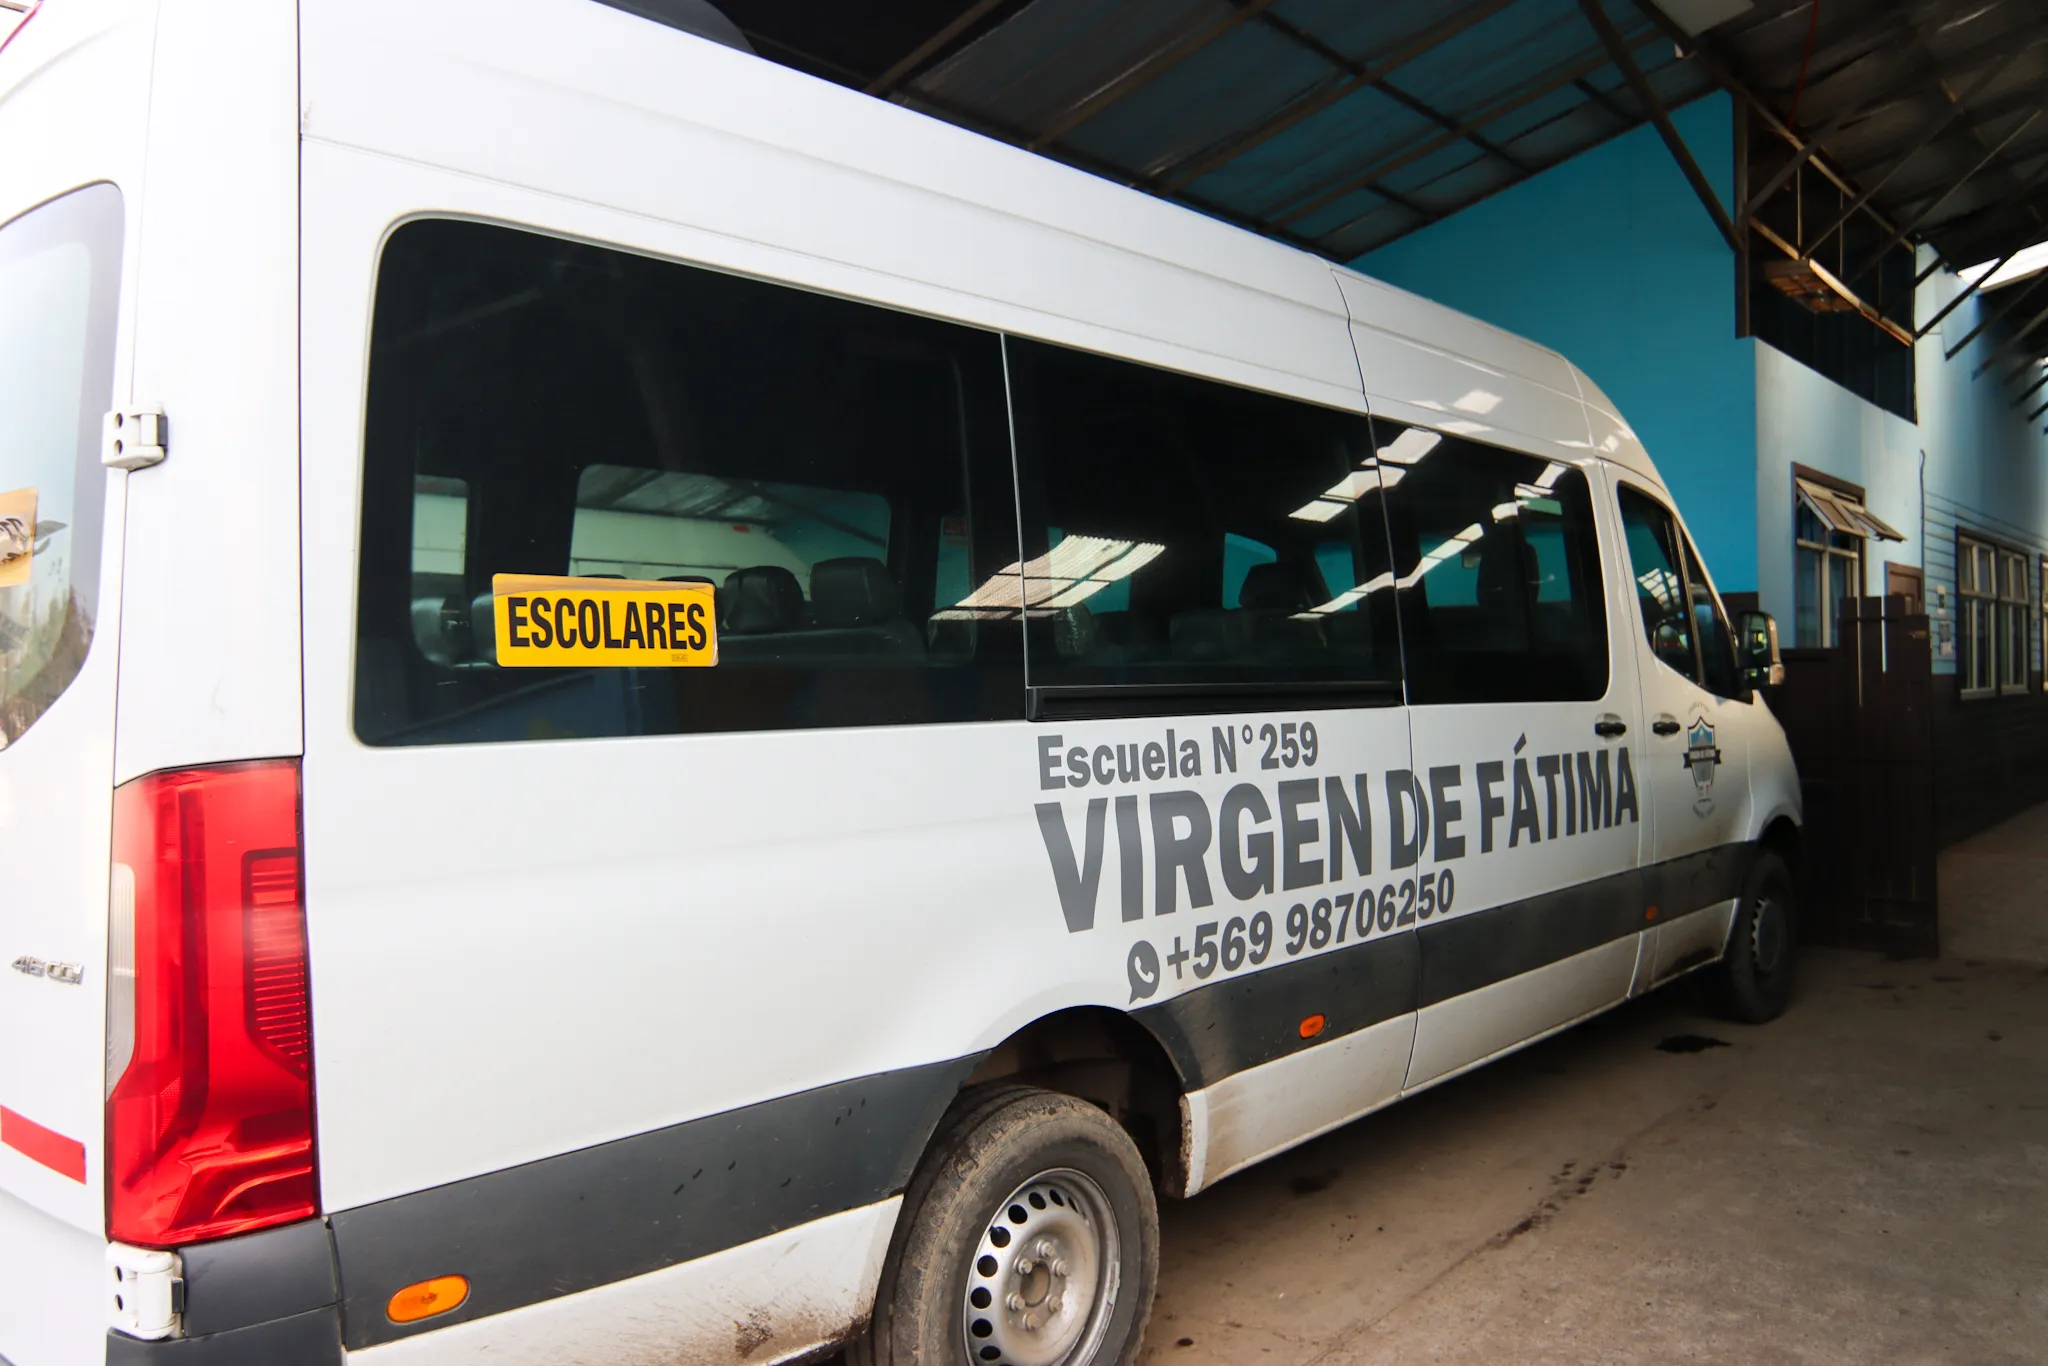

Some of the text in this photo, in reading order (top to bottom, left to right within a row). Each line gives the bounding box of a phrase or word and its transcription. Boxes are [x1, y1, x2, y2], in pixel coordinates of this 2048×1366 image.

[508, 597, 706, 650] ESCOLARES
[1037, 729, 1201, 790] Escuela
[1035, 732, 1639, 933] VIRGEN DE FÁTIMA
[1167, 868, 1454, 979] +569 98706250
